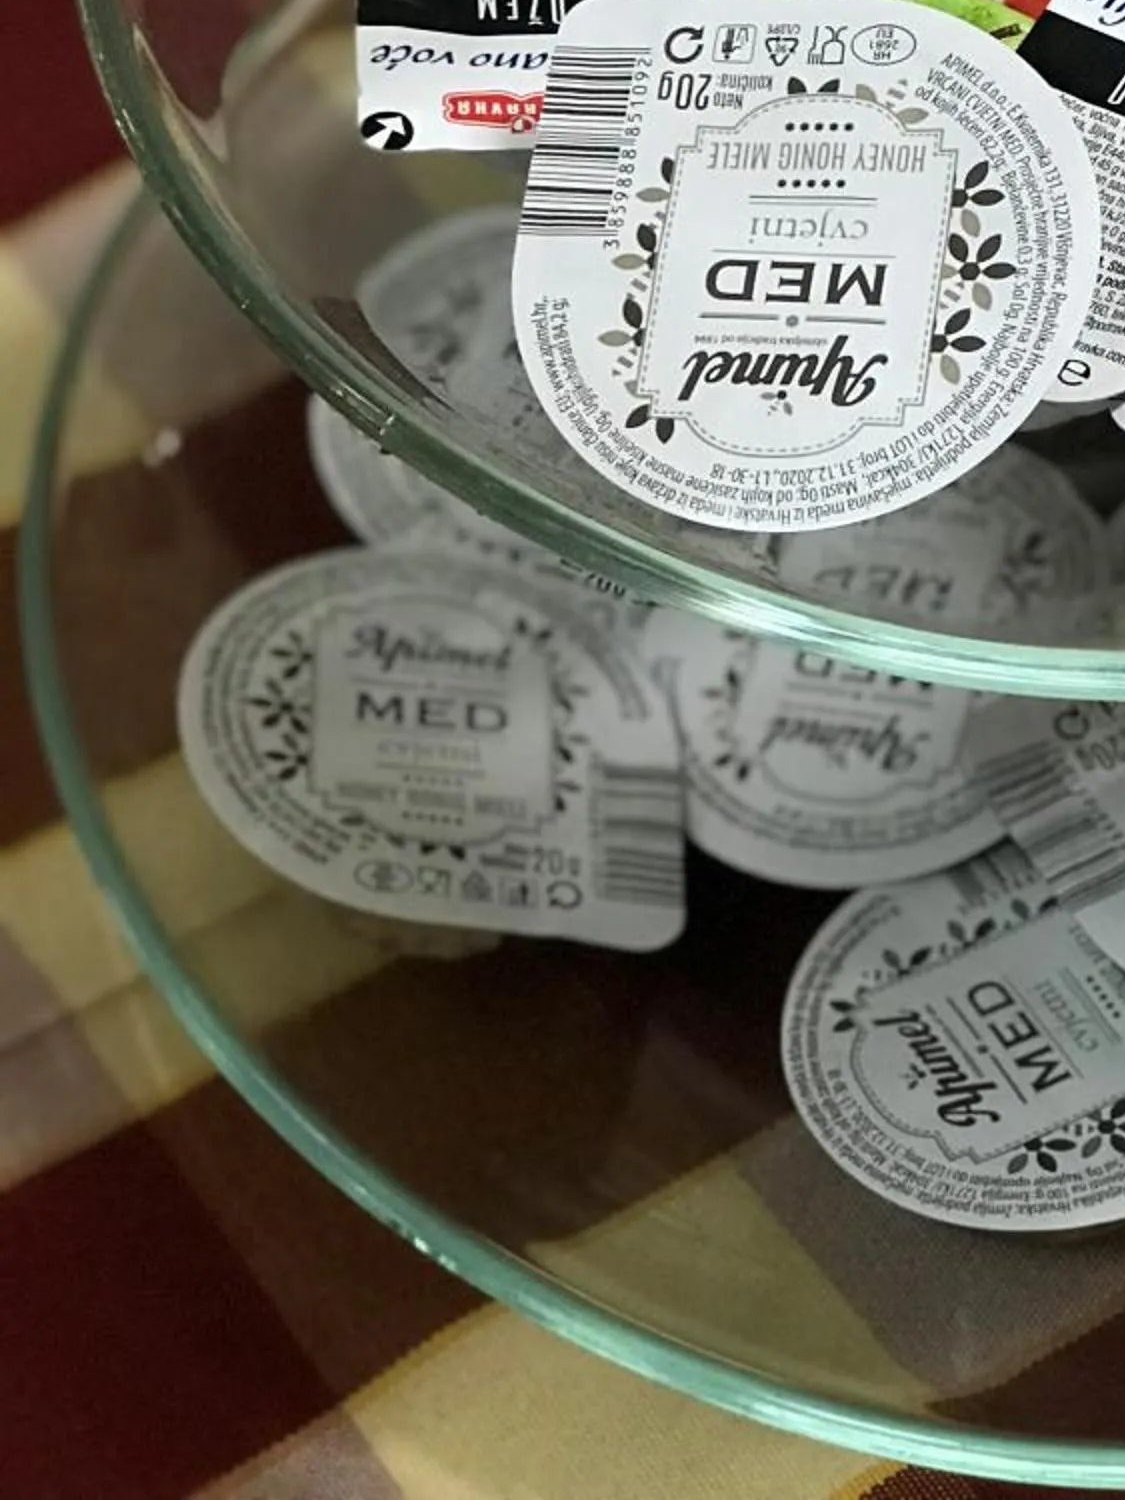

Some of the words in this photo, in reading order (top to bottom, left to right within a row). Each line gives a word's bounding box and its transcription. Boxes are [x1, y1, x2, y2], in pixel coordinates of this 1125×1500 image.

[875, 27, 894, 39] EU
[370, 43, 455, 71] voće
[873, 51, 891, 60] HR
[657, 72, 710, 111] 20g
[714, 71, 774, 91] količina:
[712, 93, 744, 110] Neto
[965, 93, 1006, 133] CVJETNI
[605, 145, 638, 232] 859888
[625, 54, 655, 135] 851092
[706, 140, 770, 170] MIELE
[777, 143, 846, 172] HONIG
[854, 142, 927, 174] HONEY
[747, 215, 870, 247] cvjetni
[1050, 193, 1072, 231] 31220
[1031, 209, 1056, 260] hranjive
[705, 258, 888, 306] MED
[1024, 261, 1048, 326] vrijednosti
[1033, 291, 1068, 351] Republika
[980, 323, 1017, 374] Najbolje
[677, 334, 891, 407] Apimel
[959, 380, 1005, 428] Energija
[968, 403, 1009, 442] Zemlja
[594, 440, 619, 465] nisu
[614, 458, 640, 485] koje
[645, 456, 685, 491] masne
[819, 478, 858, 499] Masti
[734, 499, 791, 525] Hrvatske
[740, 482, 773, 507] kojih
[807, 500, 846, 522] meda
[345, 624, 514, 674] Apimel
[356, 691, 510, 734] MED
[759, 712, 932, 773] Apimel
[967, 981, 1073, 1094] MED
[873, 1009, 1001, 1129] Apimel
